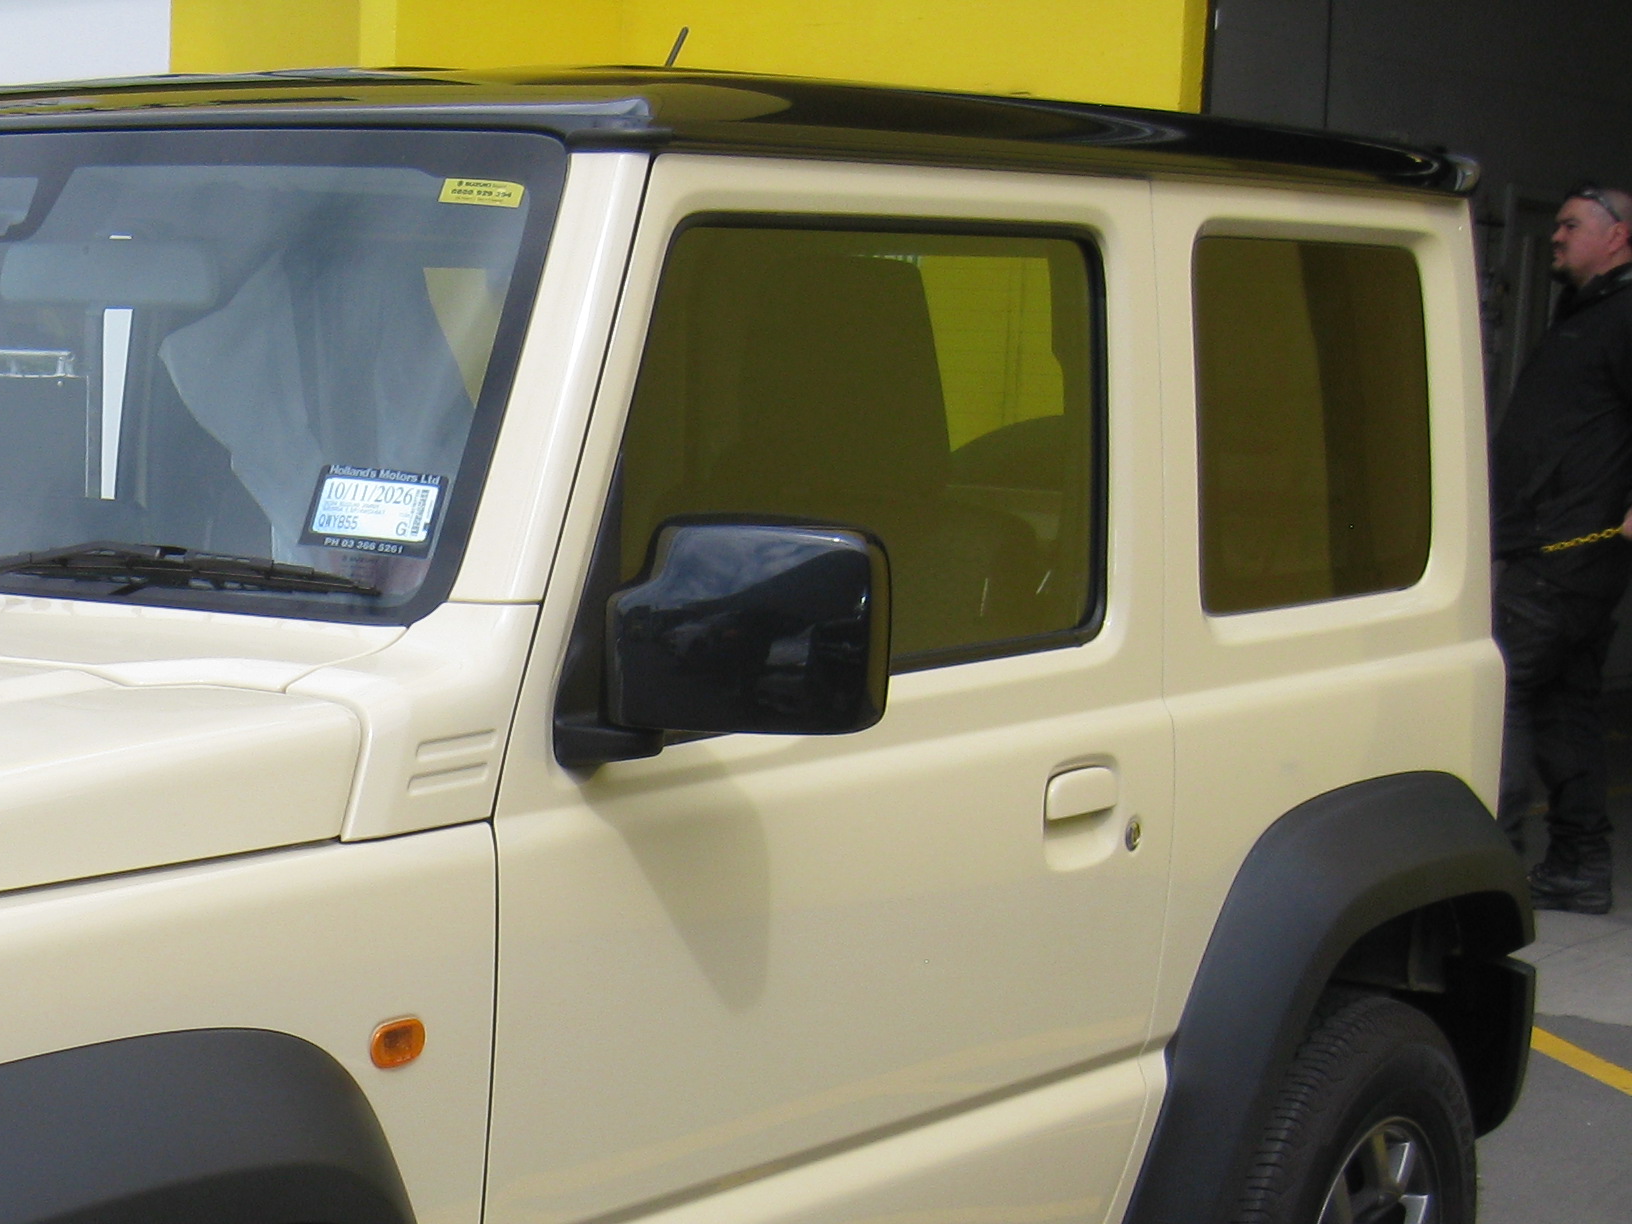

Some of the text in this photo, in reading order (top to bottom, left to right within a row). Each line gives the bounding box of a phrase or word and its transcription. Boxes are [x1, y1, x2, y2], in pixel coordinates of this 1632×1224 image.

[378, 468, 417, 482] Motors
[420, 474, 440, 485] Ltd
[327, 482, 413, 505] 10/11/2026
